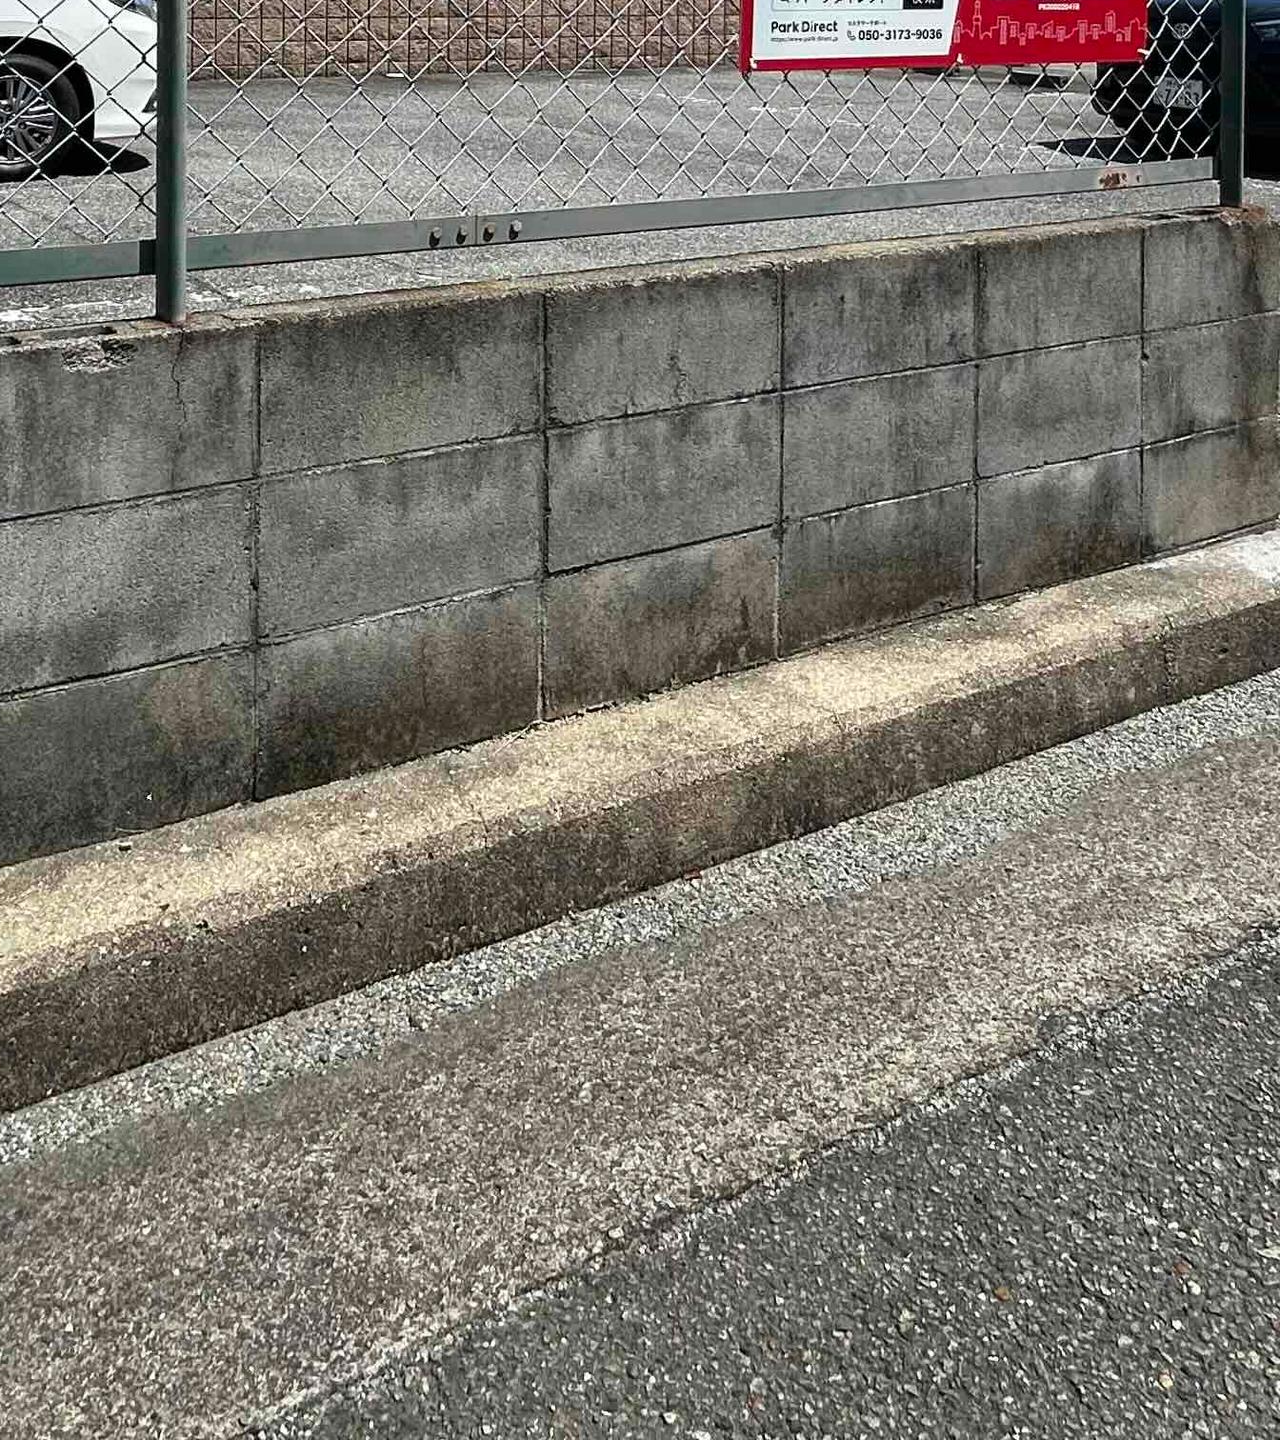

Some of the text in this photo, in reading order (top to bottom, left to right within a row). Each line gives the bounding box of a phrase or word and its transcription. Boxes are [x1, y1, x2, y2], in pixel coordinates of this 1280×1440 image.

[771, 20, 838, 33] Park Direct
[858, 28, 943, 40] 050-3173-9036
